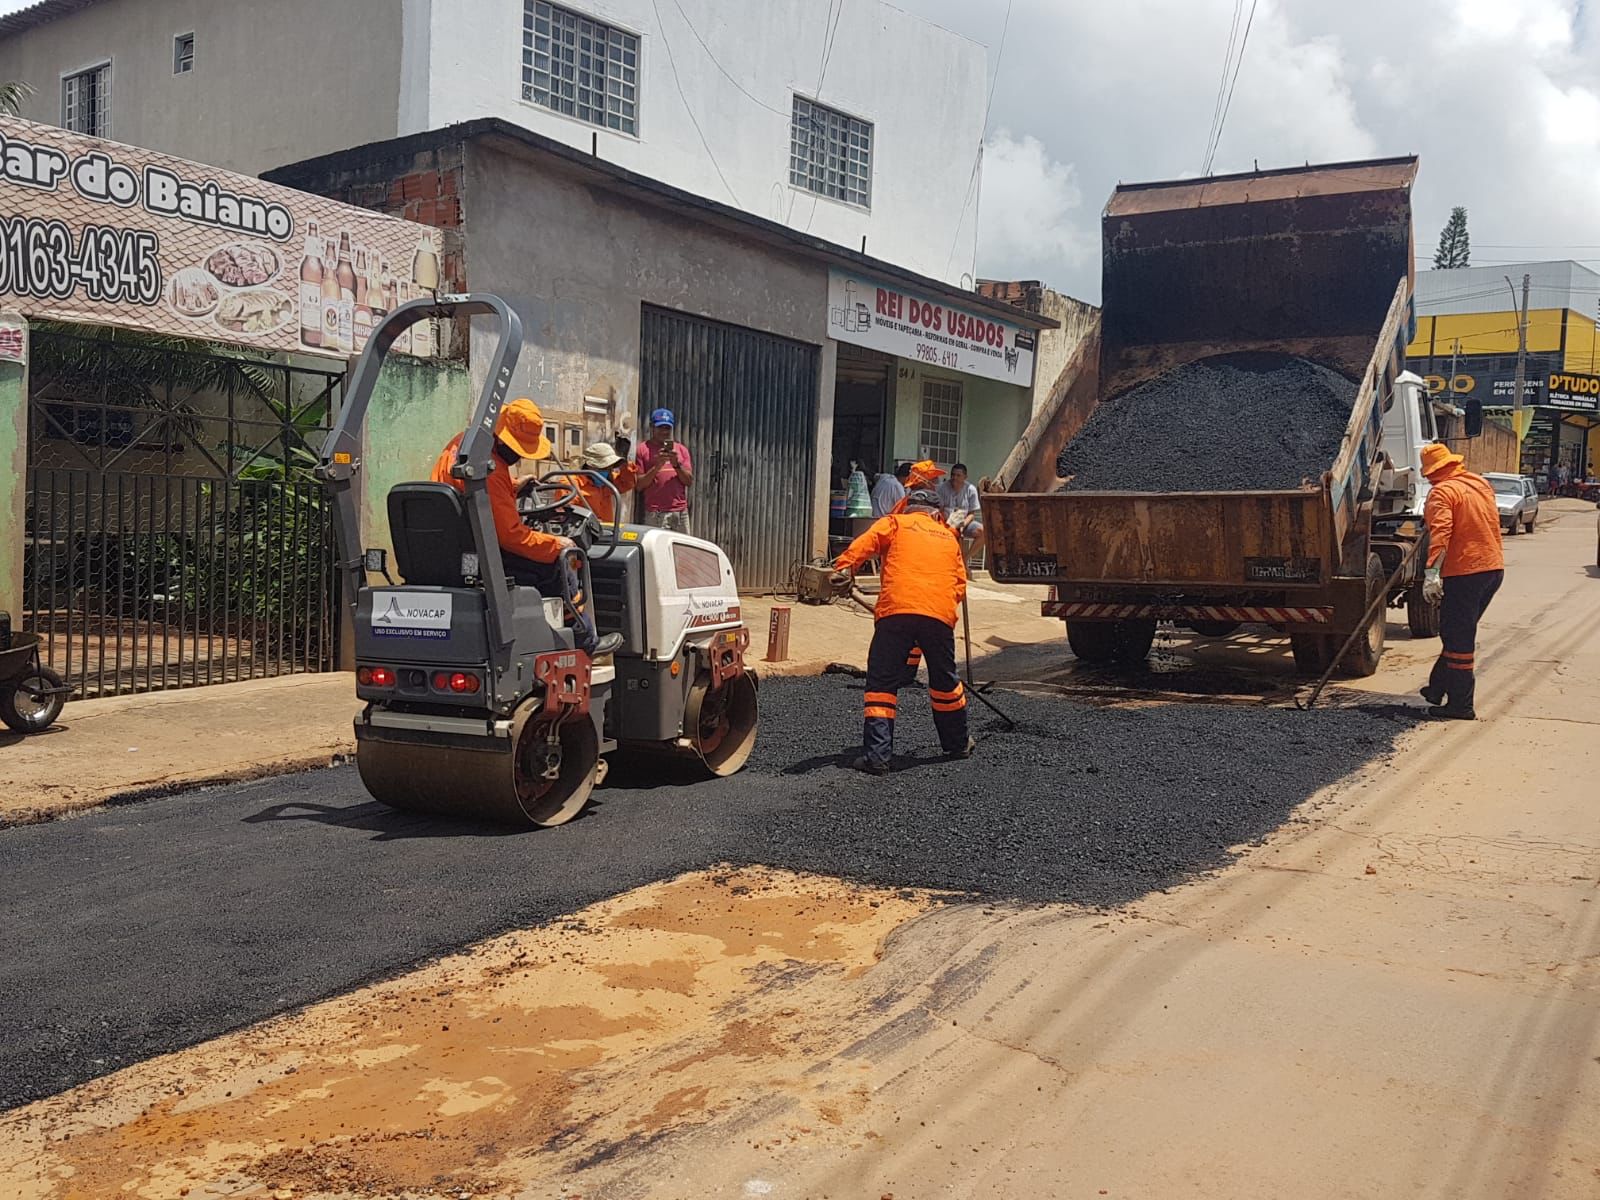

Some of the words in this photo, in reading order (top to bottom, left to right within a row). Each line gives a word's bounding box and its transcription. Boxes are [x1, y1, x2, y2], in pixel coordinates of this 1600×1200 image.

[0, 134, 67, 189] ar
[72, 152, 139, 206] do
[144, 166, 293, 241] Baiano
[876, 288, 903, 320] REI
[908, 299, 942, 331] DOS
[947, 310, 1004, 348] USADOS
[1494, 380, 1544, 388] FERRGENS
[1549, 375, 1599, 394] D'TUDO
[406, 608, 446, 619] NOVACAP
[386, 628, 413, 636] EXCLUSIVO
[422, 630, 447, 638] SERVIÇO
